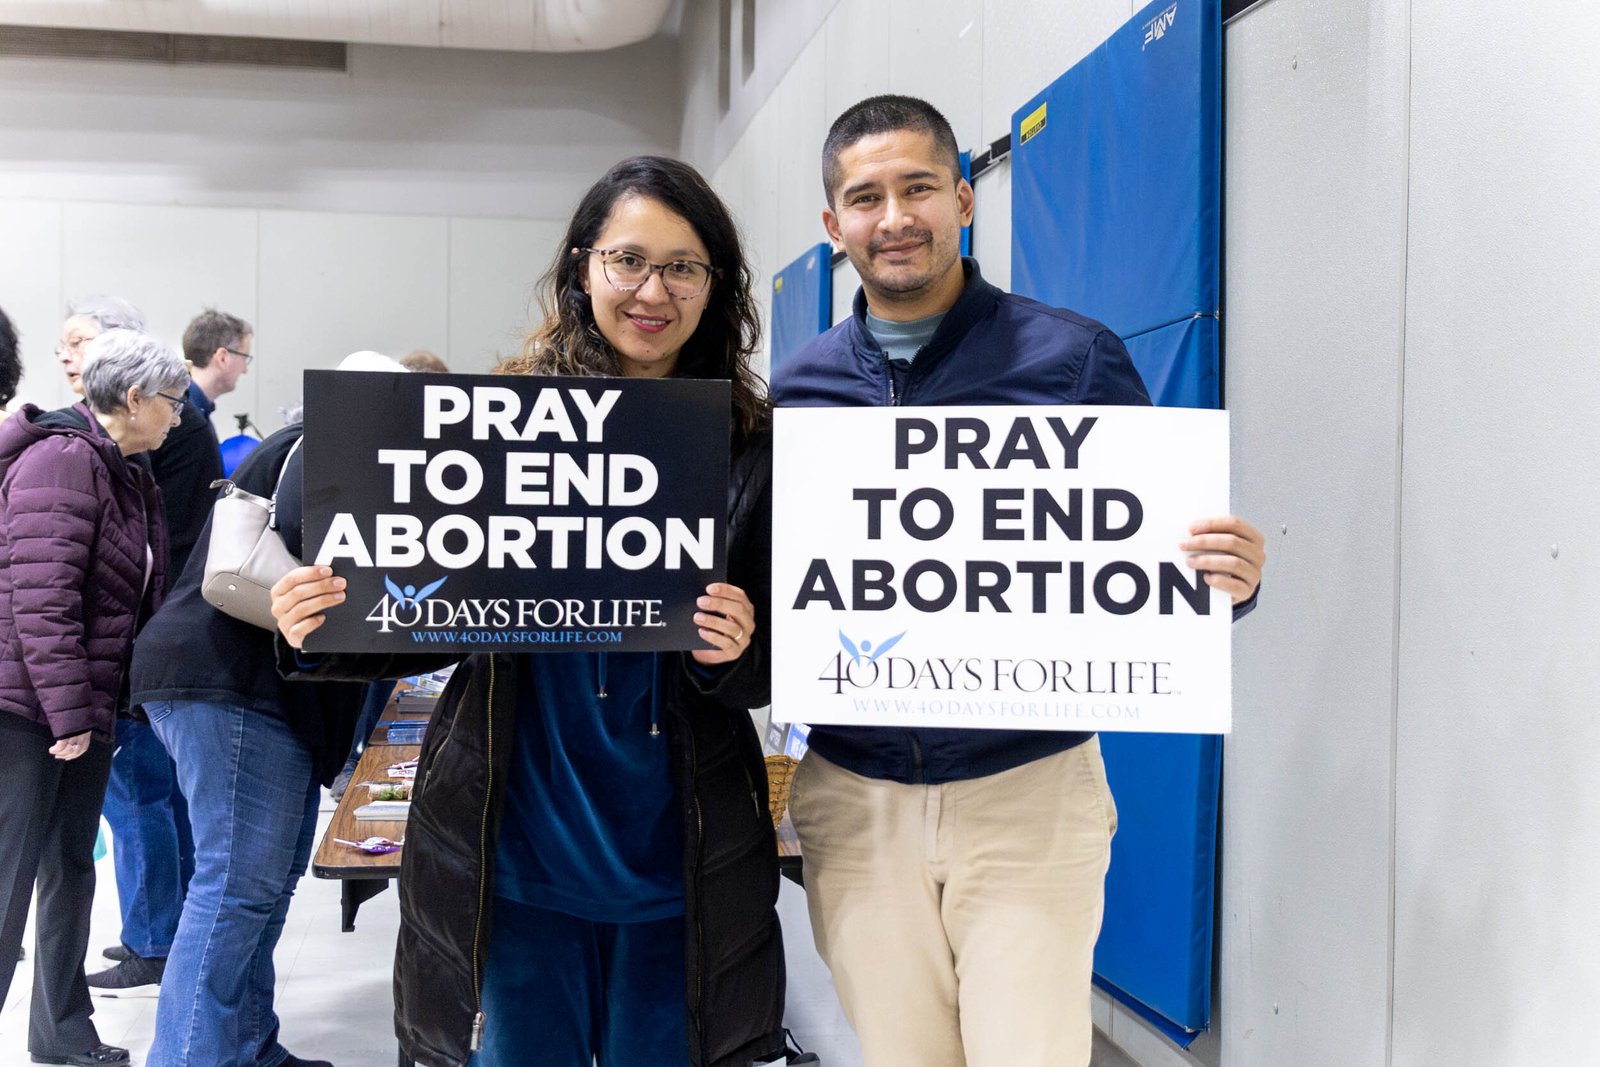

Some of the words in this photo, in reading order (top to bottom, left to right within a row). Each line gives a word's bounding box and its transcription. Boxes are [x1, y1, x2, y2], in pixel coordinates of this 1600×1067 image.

[1143, 6, 1178, 45] AMF
[423, 384, 623, 443] PRAY
[895, 416, 1099, 470] PRAY
[378, 448, 484, 505] TO
[505, 451, 659, 507] END
[852, 487, 955, 542] TO
[982, 488, 1144, 542] END
[314, 513, 715, 571] ABORTION
[365, 592, 423, 633] 40
[424, 598, 511, 627] DAYS
[515, 598, 590, 627] FOR
[792, 558, 1211, 616] ABORTION
[411, 631, 623, 643] WWW.40DAYSFORLIFE.COM
[818, 650, 880, 695] 40
[886, 656, 982, 691] DAYS
[993, 658, 1079, 693] FOR
[853, 698, 1141, 720] WWW.40DAYSFORLIFE.COM
